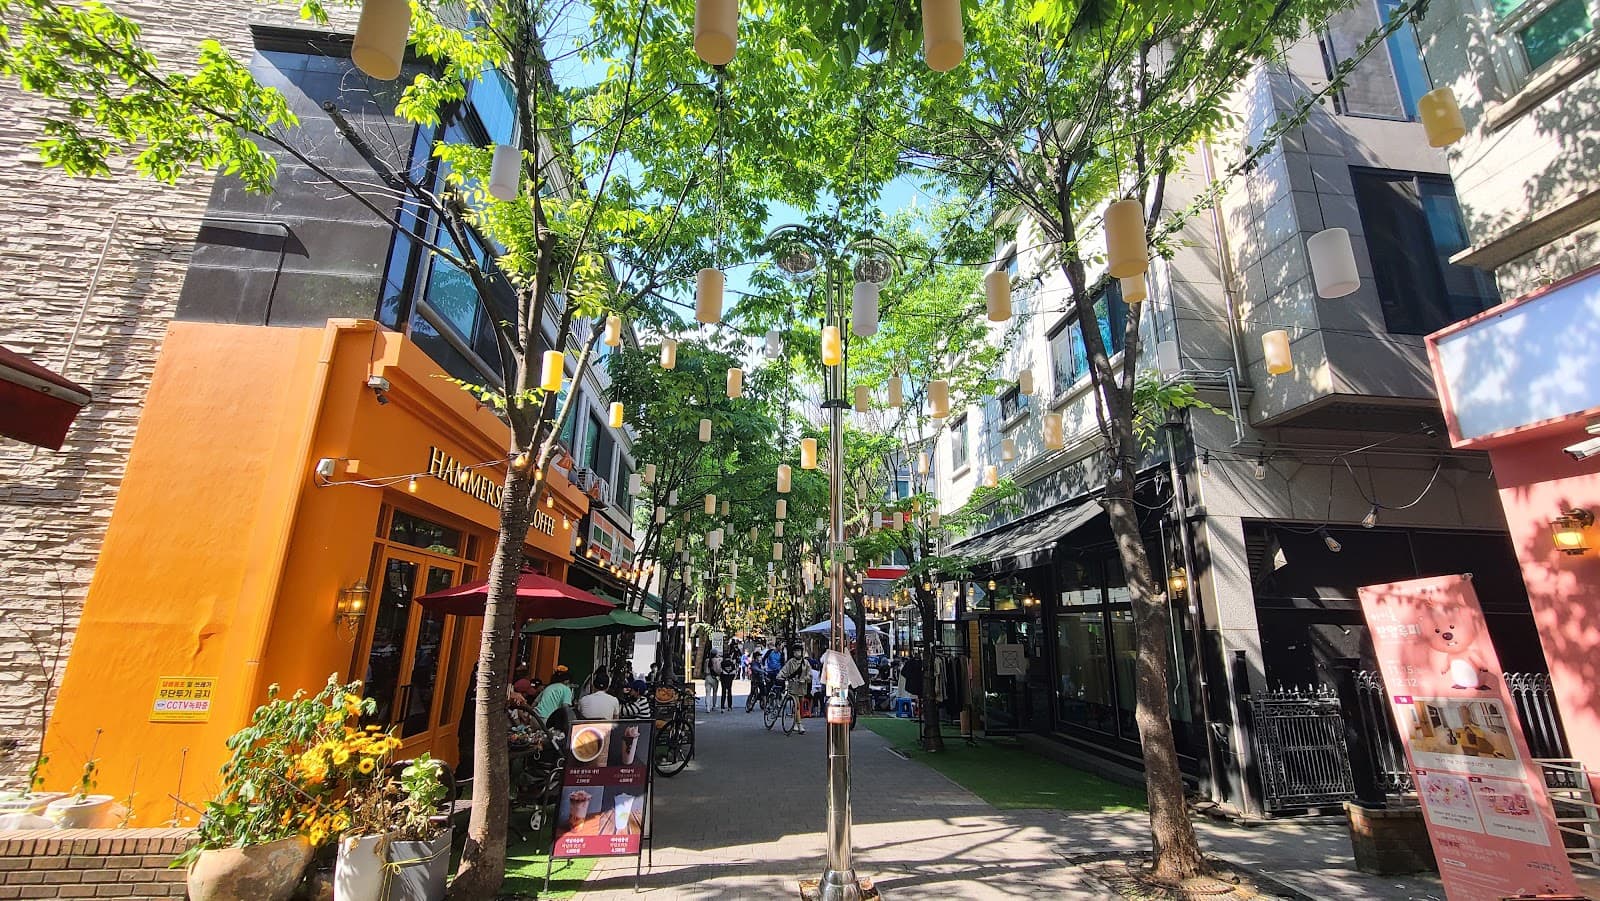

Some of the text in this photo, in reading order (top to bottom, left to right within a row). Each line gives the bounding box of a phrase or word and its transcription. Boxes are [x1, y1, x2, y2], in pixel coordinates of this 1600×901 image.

[530, 508, 556, 537] OFFEE
[160, 689, 211, 698] 무단투기 금지
[166, 701, 208, 709] CCTV녹화중
